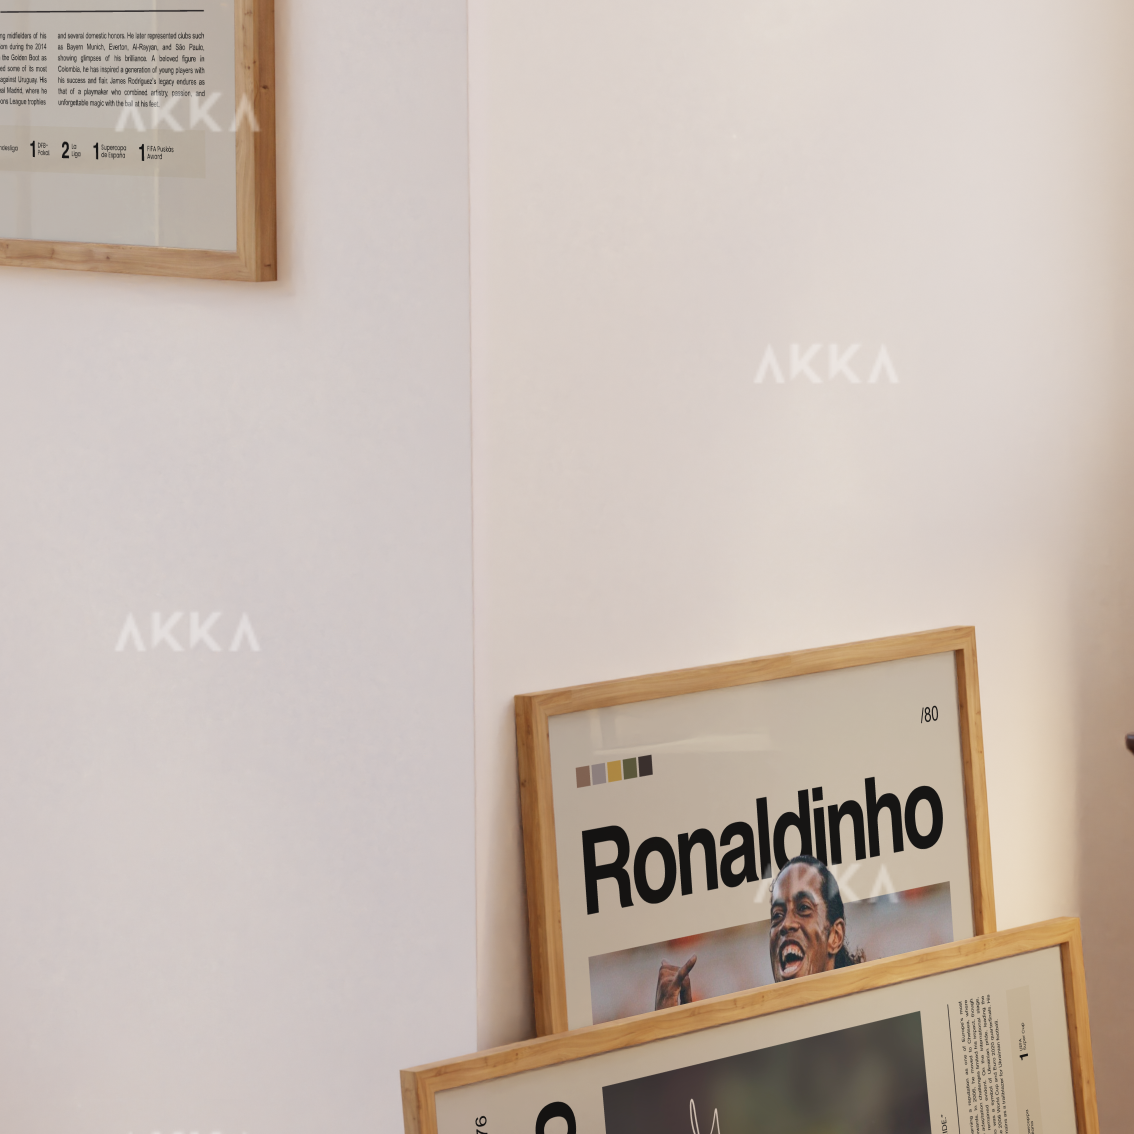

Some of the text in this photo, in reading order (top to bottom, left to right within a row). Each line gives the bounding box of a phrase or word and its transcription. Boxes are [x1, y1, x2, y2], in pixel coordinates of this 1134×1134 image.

[30, 141, 35, 157] 1
[62, 142, 69, 159] 2
[93, 142, 98, 160] 1
[139, 144, 144, 161] 1
[920, 706, 939, 724] /80
[581, 777, 943, 914] Ronaldinho
